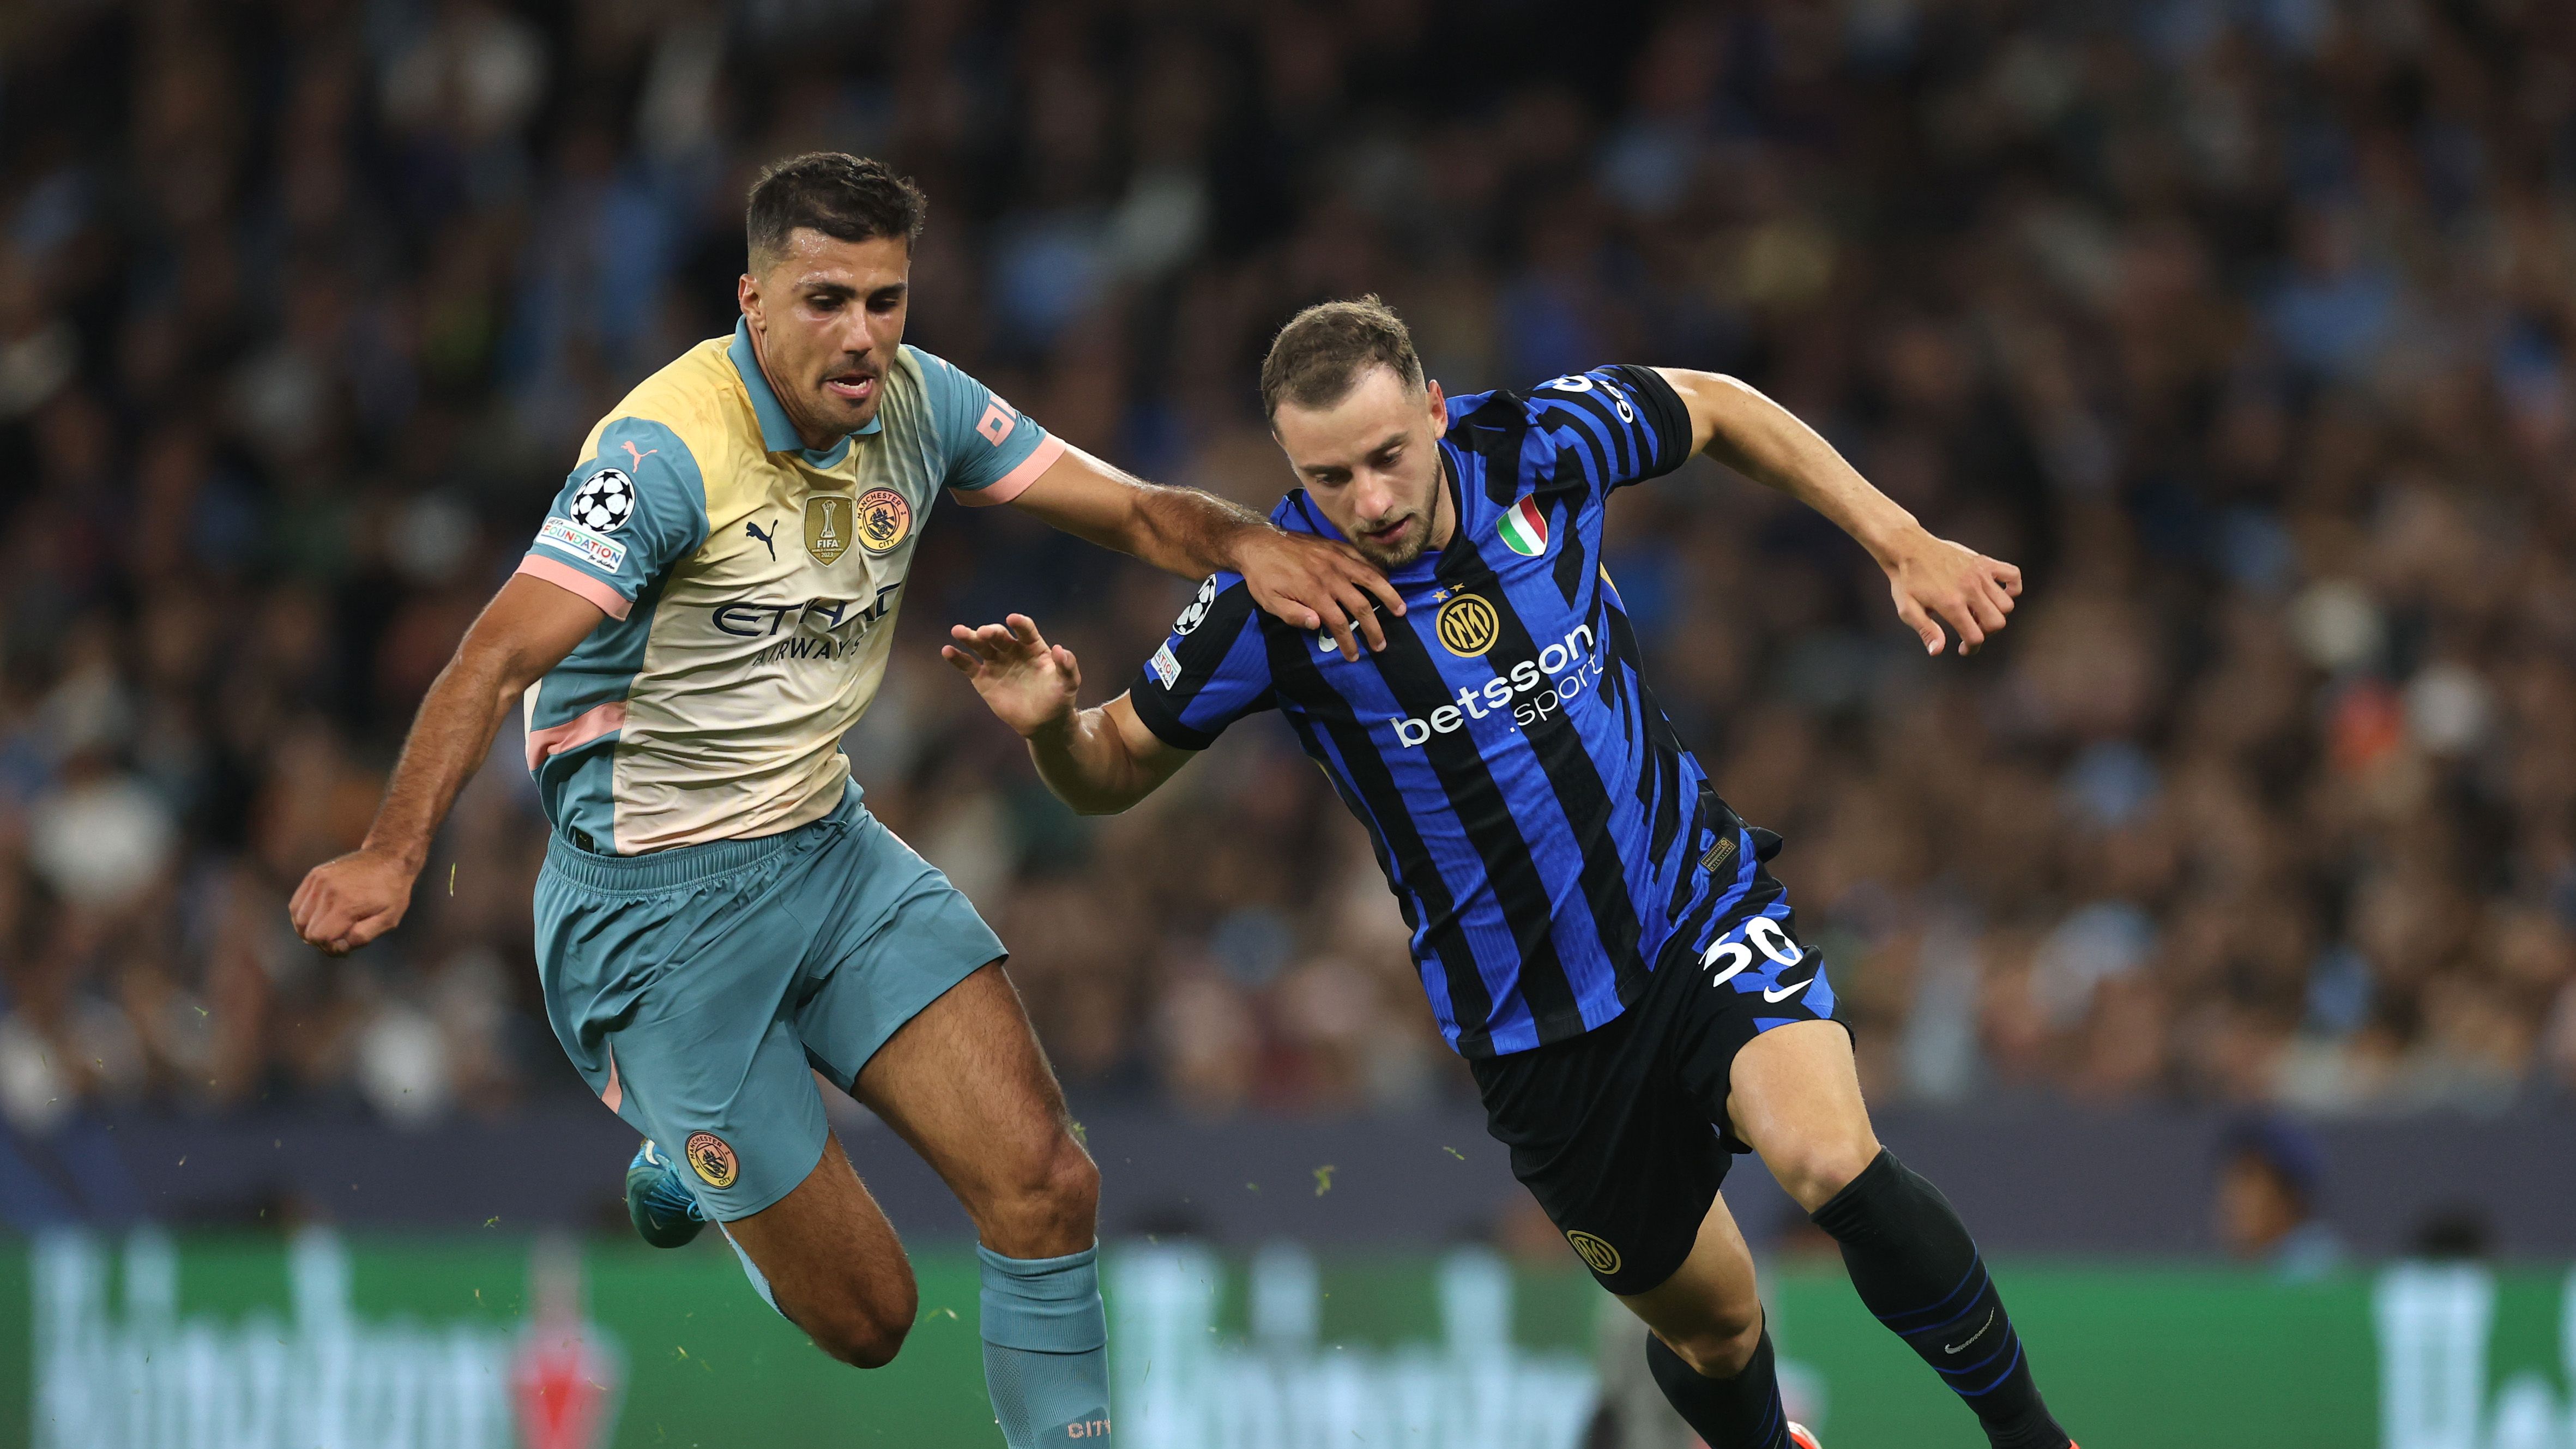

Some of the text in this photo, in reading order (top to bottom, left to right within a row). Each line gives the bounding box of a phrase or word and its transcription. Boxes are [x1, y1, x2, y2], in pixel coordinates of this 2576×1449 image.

[858, 493, 901, 519] MANCHESTER
[542, 524, 621, 564] FOUNDATION
[817, 540, 838, 548] FIFA
[878, 538, 895, 548] CITY
[1389, 624, 1594, 748] betsson
[689, 1136, 722, 1160] MANCHESTER
[719, 1176, 731, 1186] CITY
